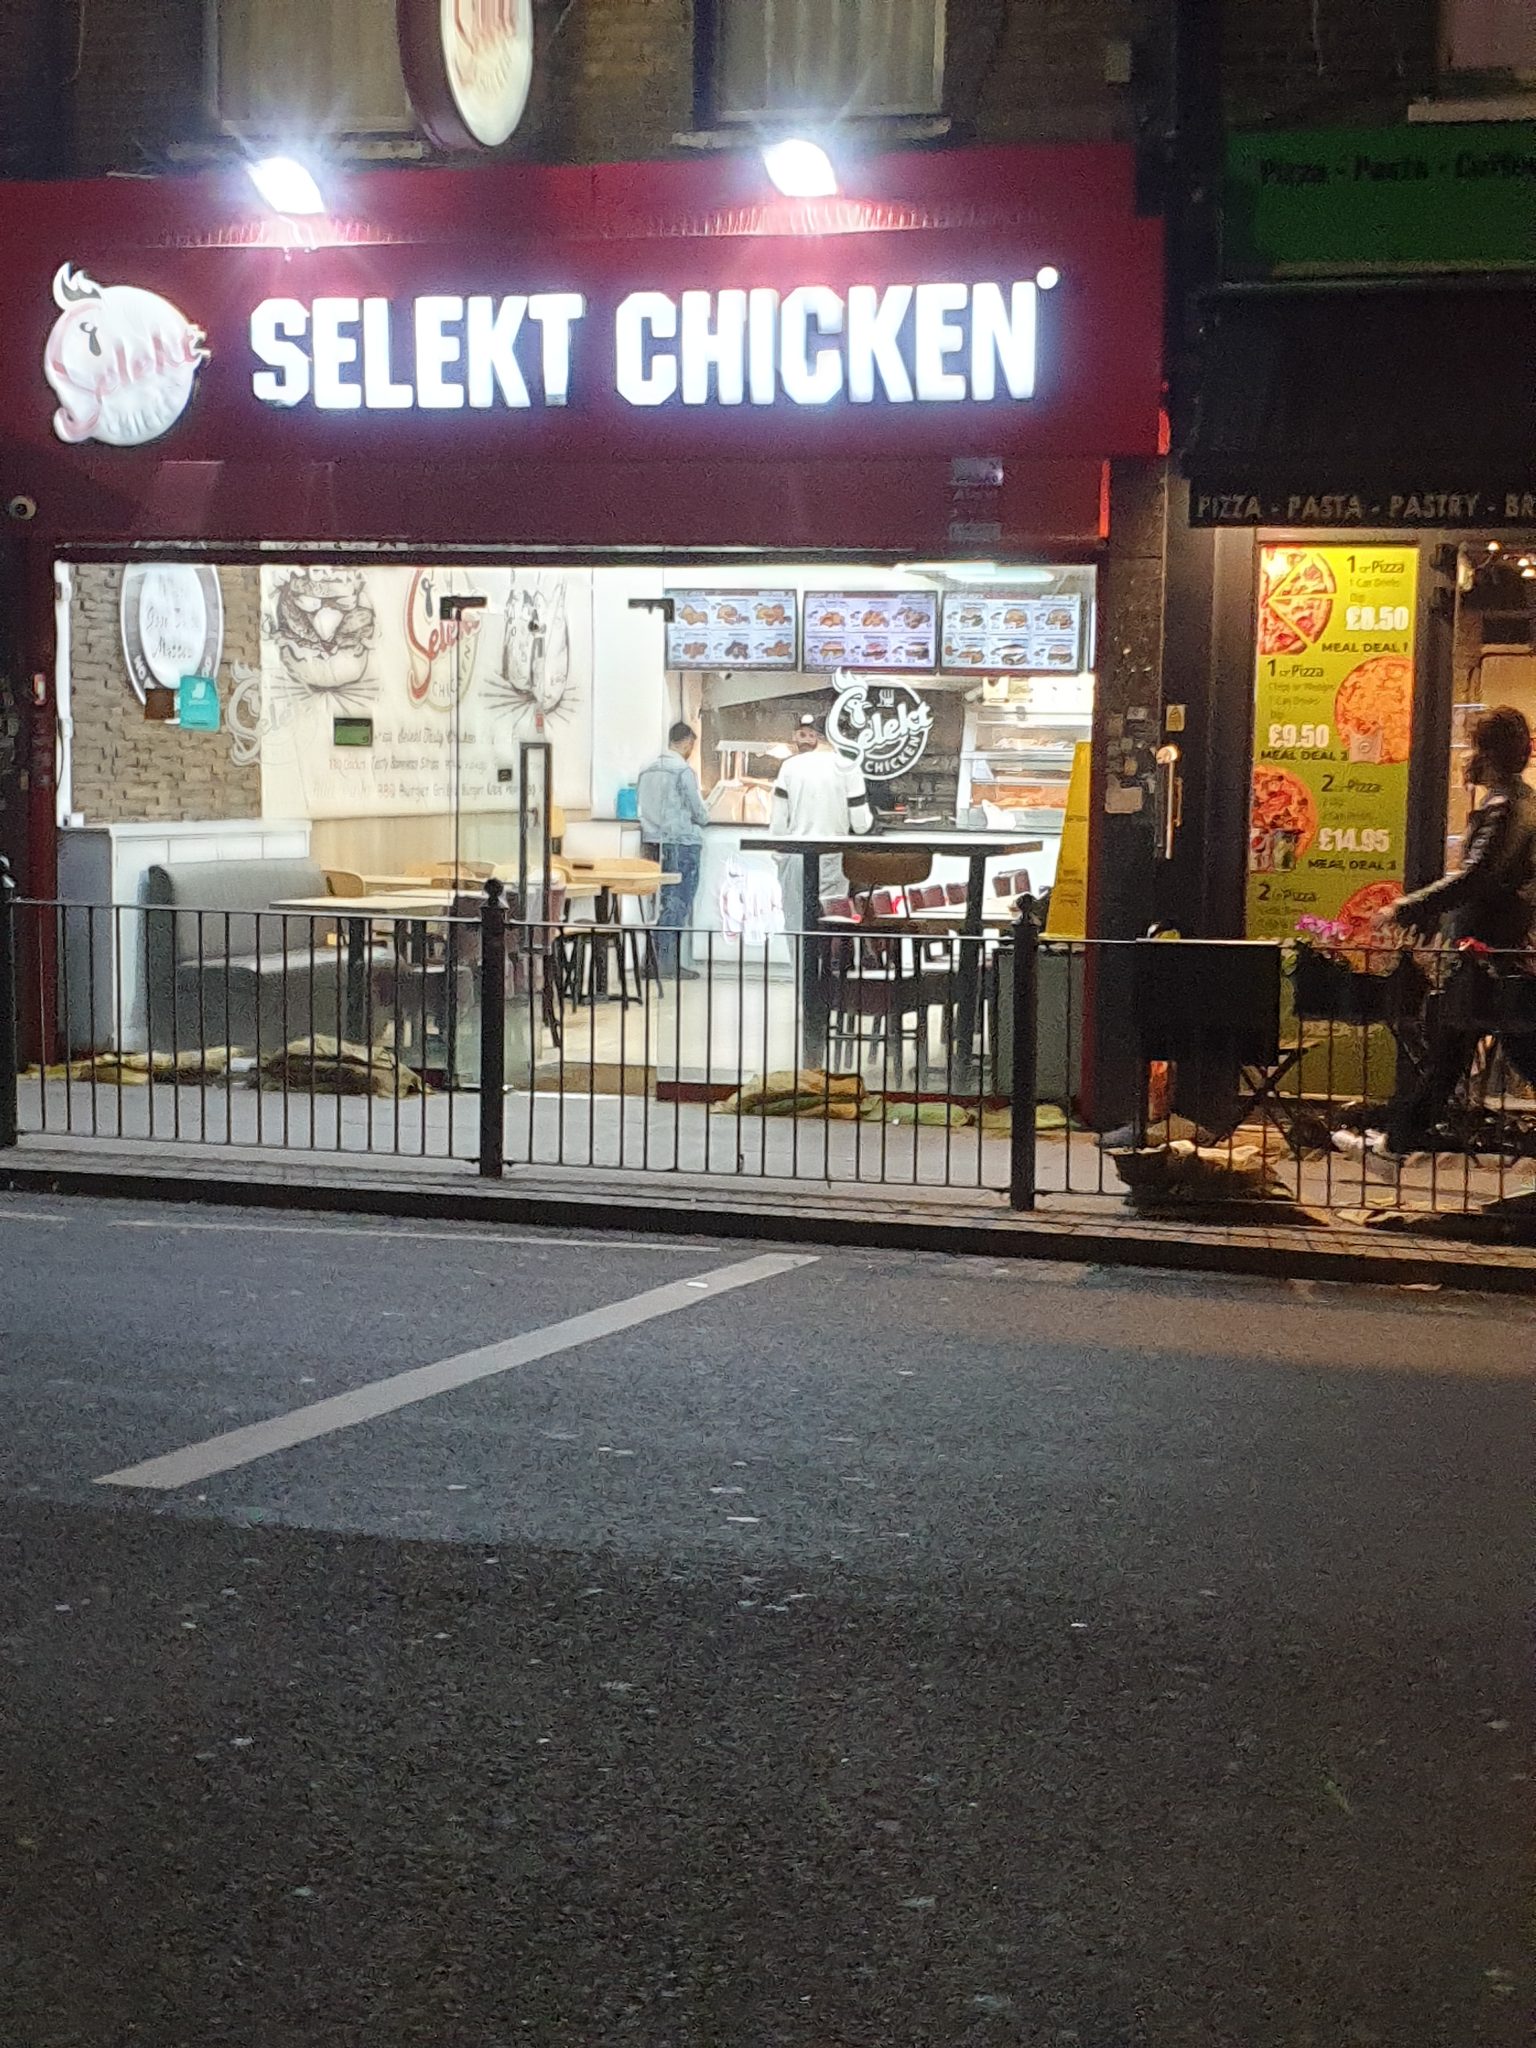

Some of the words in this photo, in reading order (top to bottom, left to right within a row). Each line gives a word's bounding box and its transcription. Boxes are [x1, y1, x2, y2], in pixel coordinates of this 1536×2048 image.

[250, 291, 587, 409] SELEKT
[614, 280, 1038, 408] CHICKEN
[1197, 495, 1262, 518] PIZZA
[1287, 494, 1362, 519] PASTA
[1388, 493, 1480, 518] PASTRY
[1371, 560, 1405, 574] Pizza
[1346, 605, 1410, 632] £8.50
[1321, 642, 1360, 653] MEAL
[1362, 641, 1399, 653] DEAL
[1291, 664, 1325, 677] Pizza
[1268, 723, 1330, 748] £9.50
[864, 735, 921, 774] CHICKEN
[1260, 750, 1297, 761] MEAL
[1300, 750, 1336, 761] DEAL
[1321, 774, 1335, 792] 2
[1350, 859, 1384, 870] DEAL
[1257, 882, 1271, 900] 2
